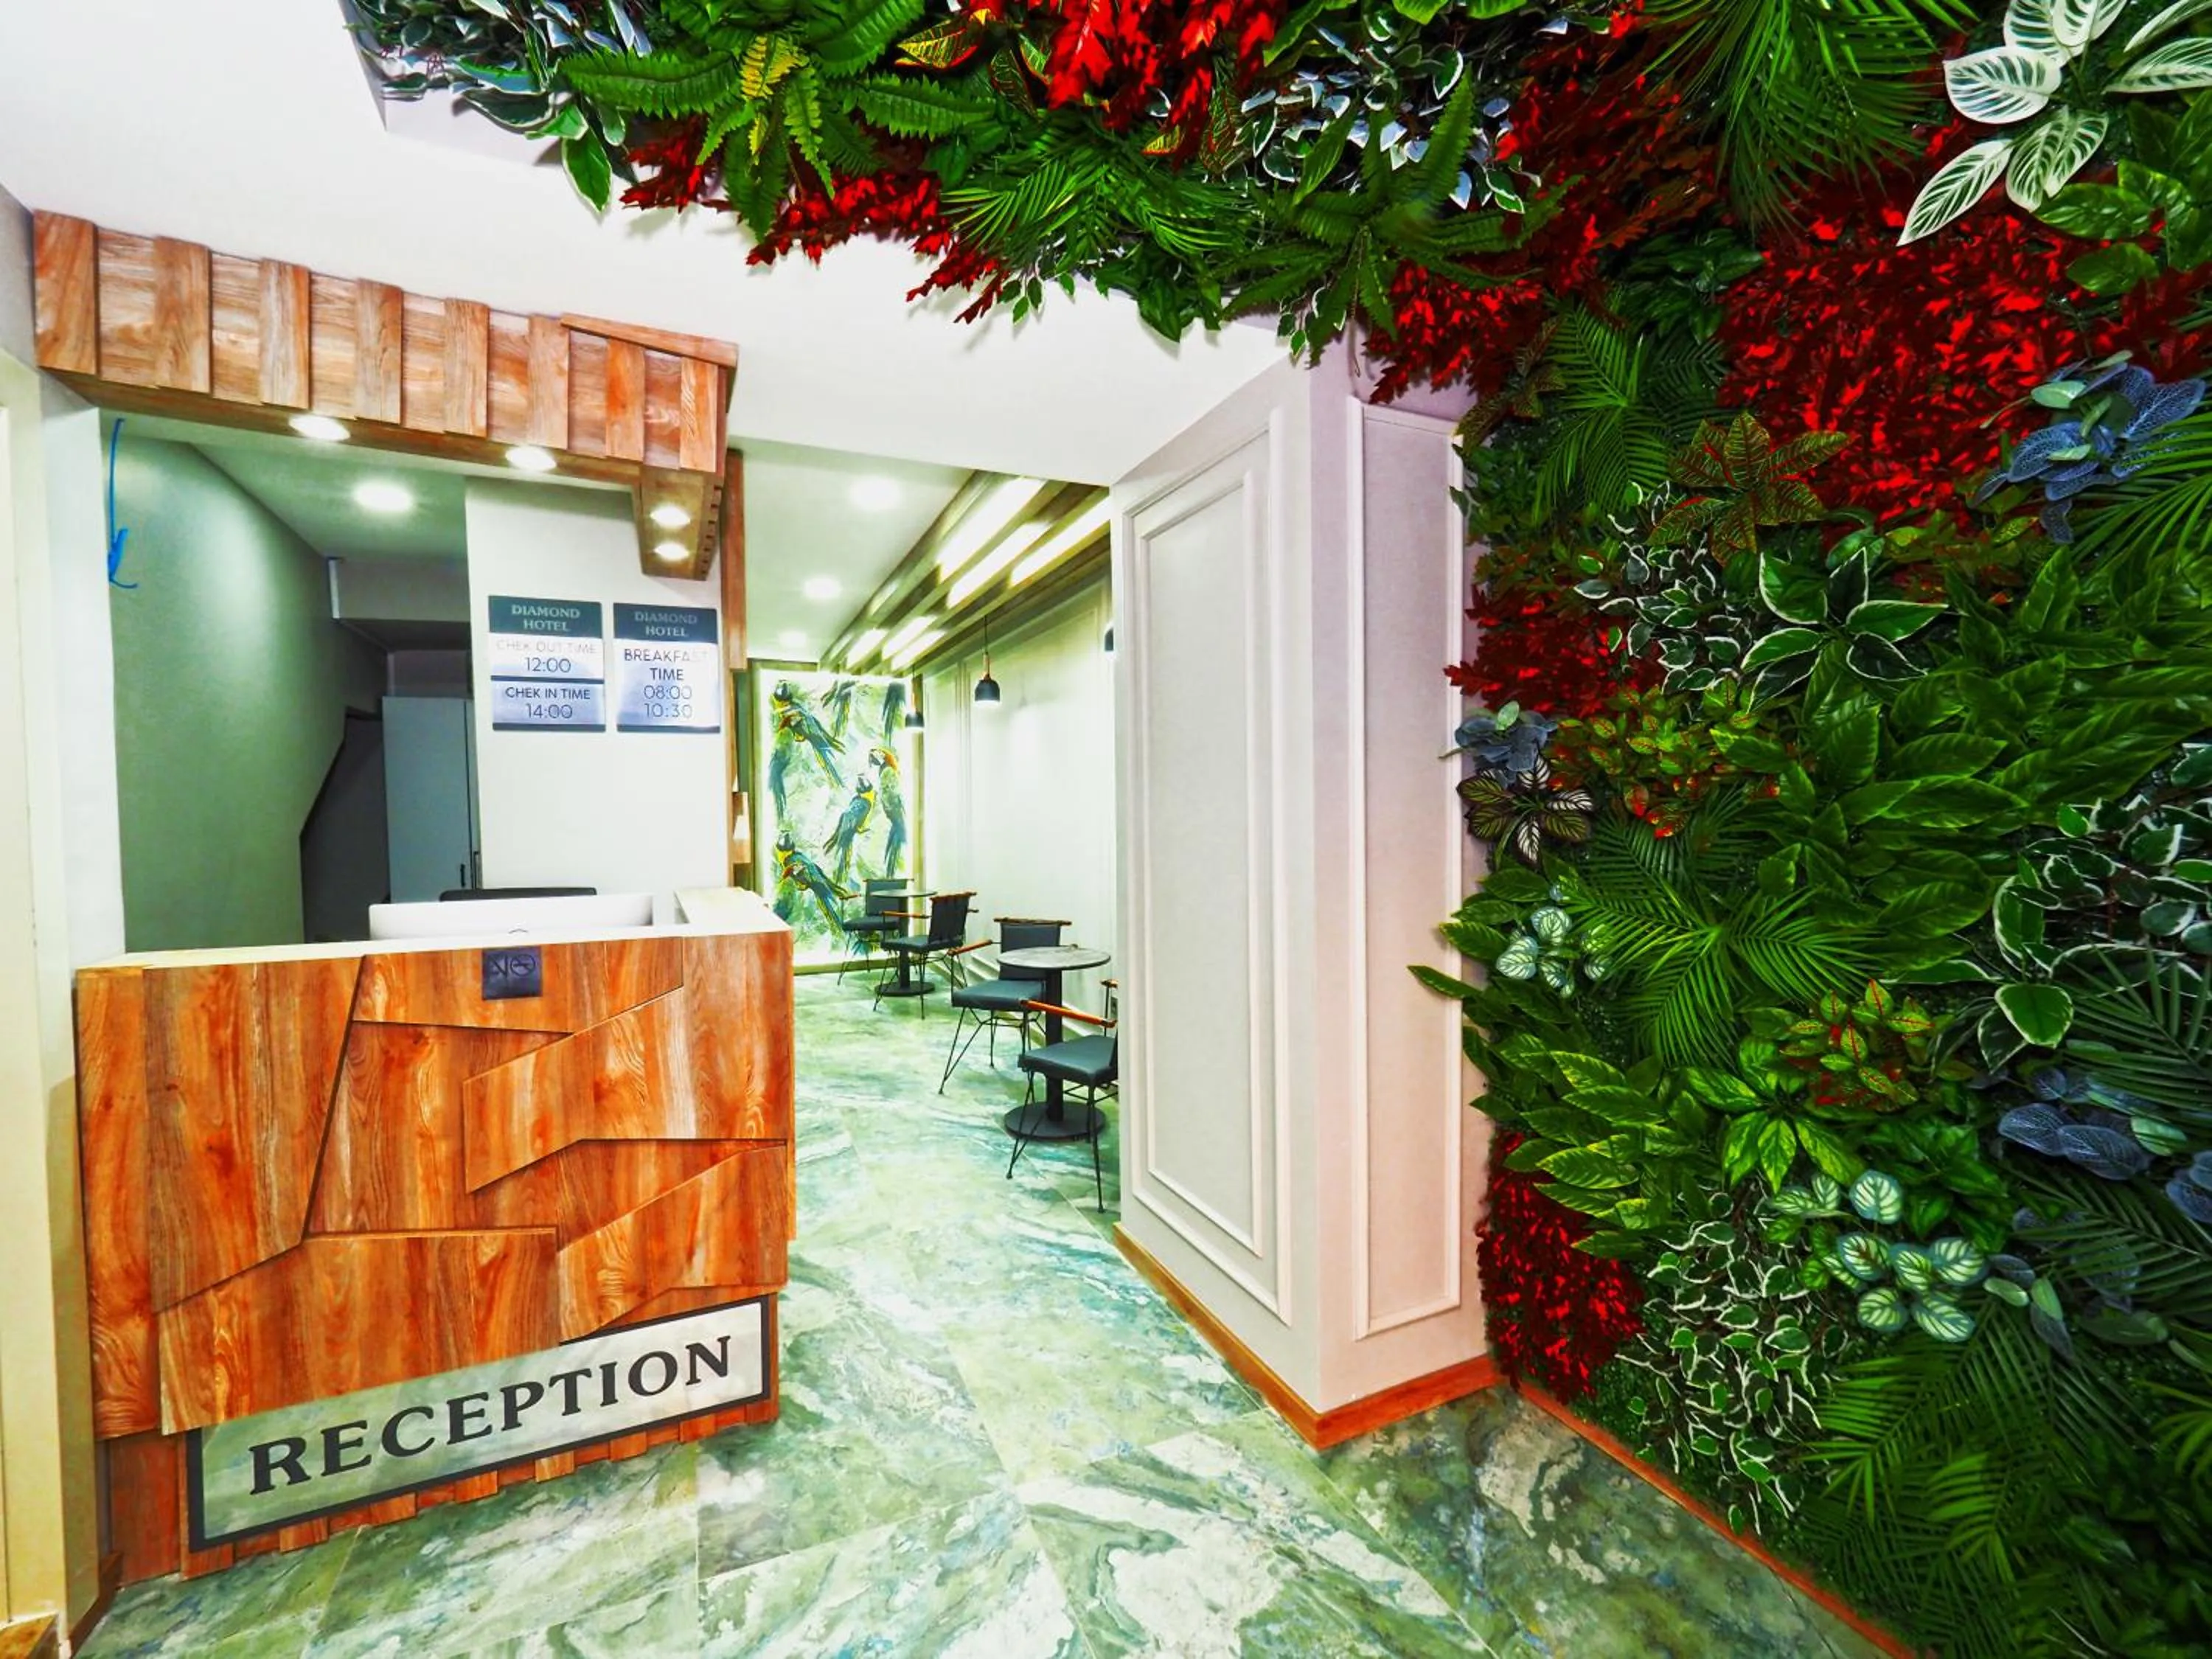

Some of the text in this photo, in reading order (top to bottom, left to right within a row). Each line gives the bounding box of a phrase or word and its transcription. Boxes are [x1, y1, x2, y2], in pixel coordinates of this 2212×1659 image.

[512, 604, 581, 619] DIAMOND
[635, 611, 698, 625] DIAMOND
[523, 619, 570, 633] HOTEL
[645, 625, 689, 638] HOTEL
[536, 641, 563, 653] OUT
[625, 648, 708, 663] BREAKFA
[525, 657, 571, 672] 12:00
[650, 667, 684, 681] TIME
[505, 686, 591, 700] CHEK IN TIME
[644, 685, 692, 700] 08:00
[526, 703, 573, 720] 14:00
[644, 703, 692, 718] 10:30
[248, 1335, 731, 1495] RECEPTION
